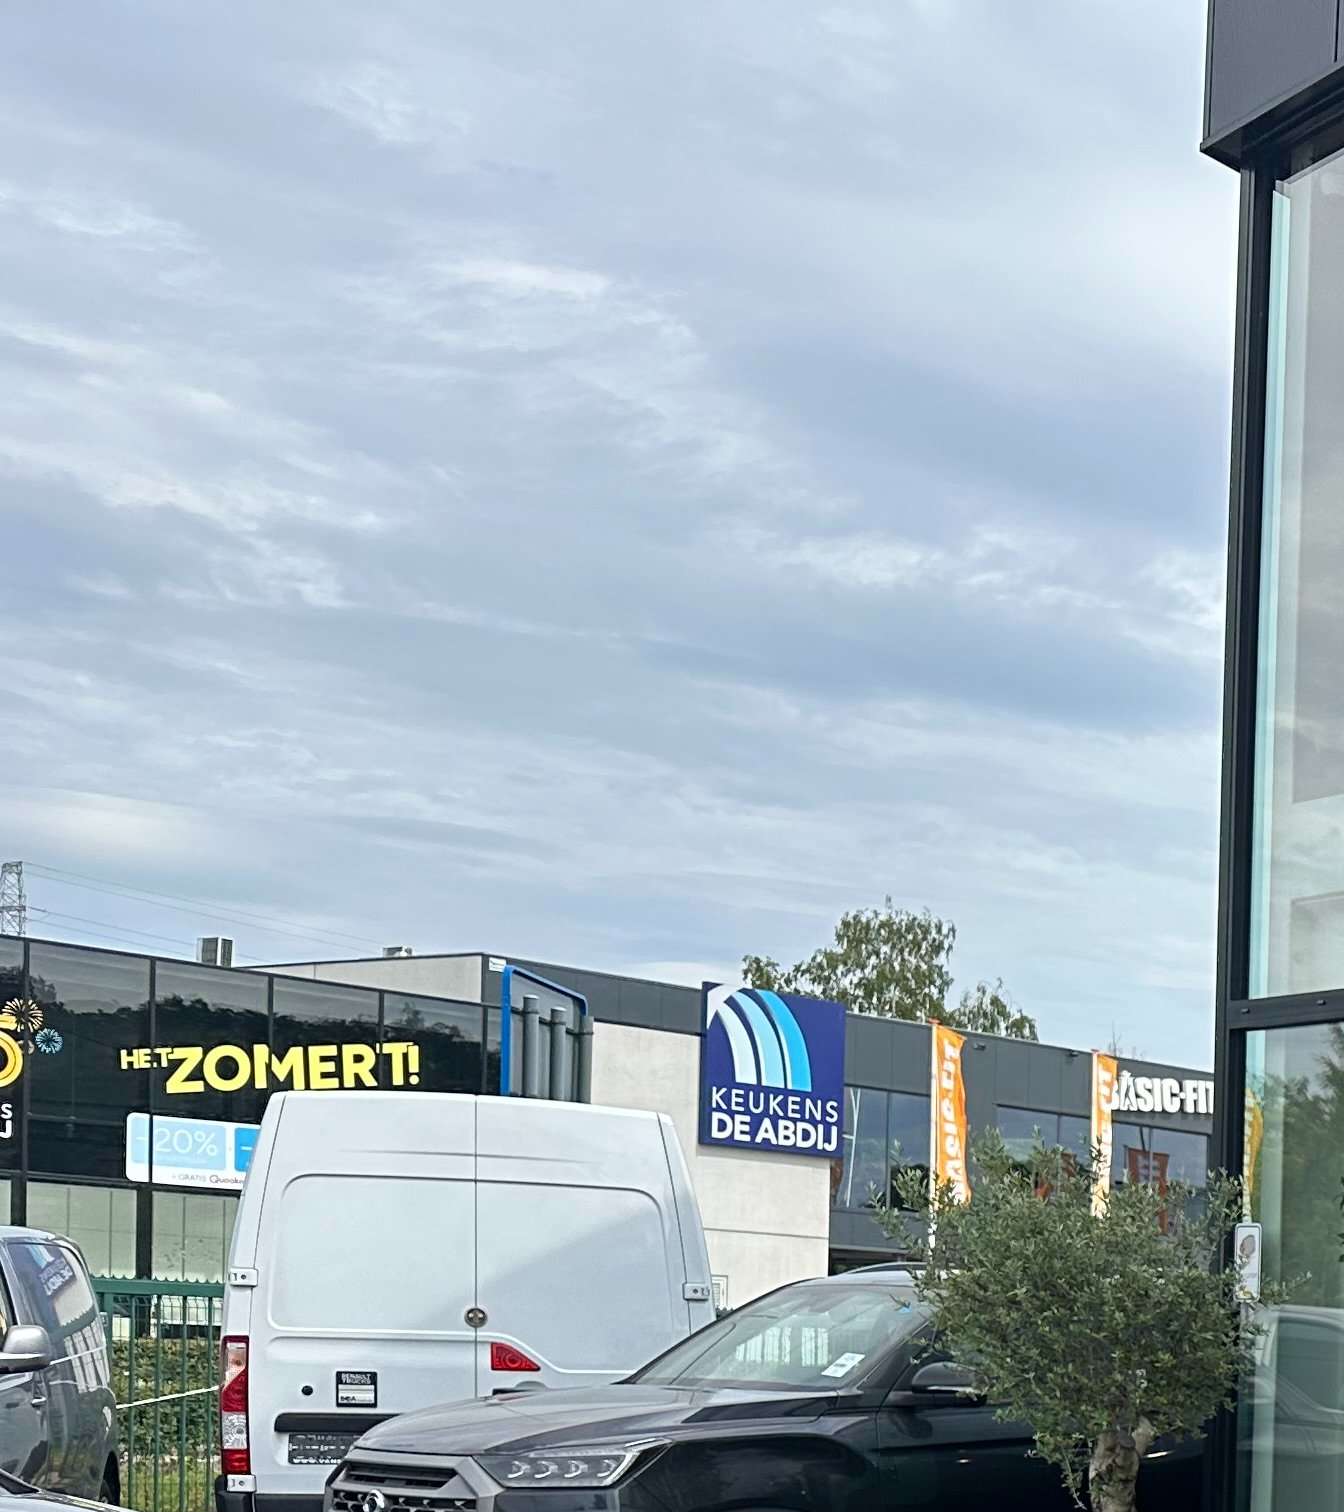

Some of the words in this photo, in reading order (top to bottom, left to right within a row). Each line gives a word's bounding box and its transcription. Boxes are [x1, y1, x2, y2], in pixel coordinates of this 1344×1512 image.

[711, 1086, 838, 1123] KEUKENS
[711, 1111, 751, 1142] DE
[754, 1117, 838, 1152] ABDIJ
